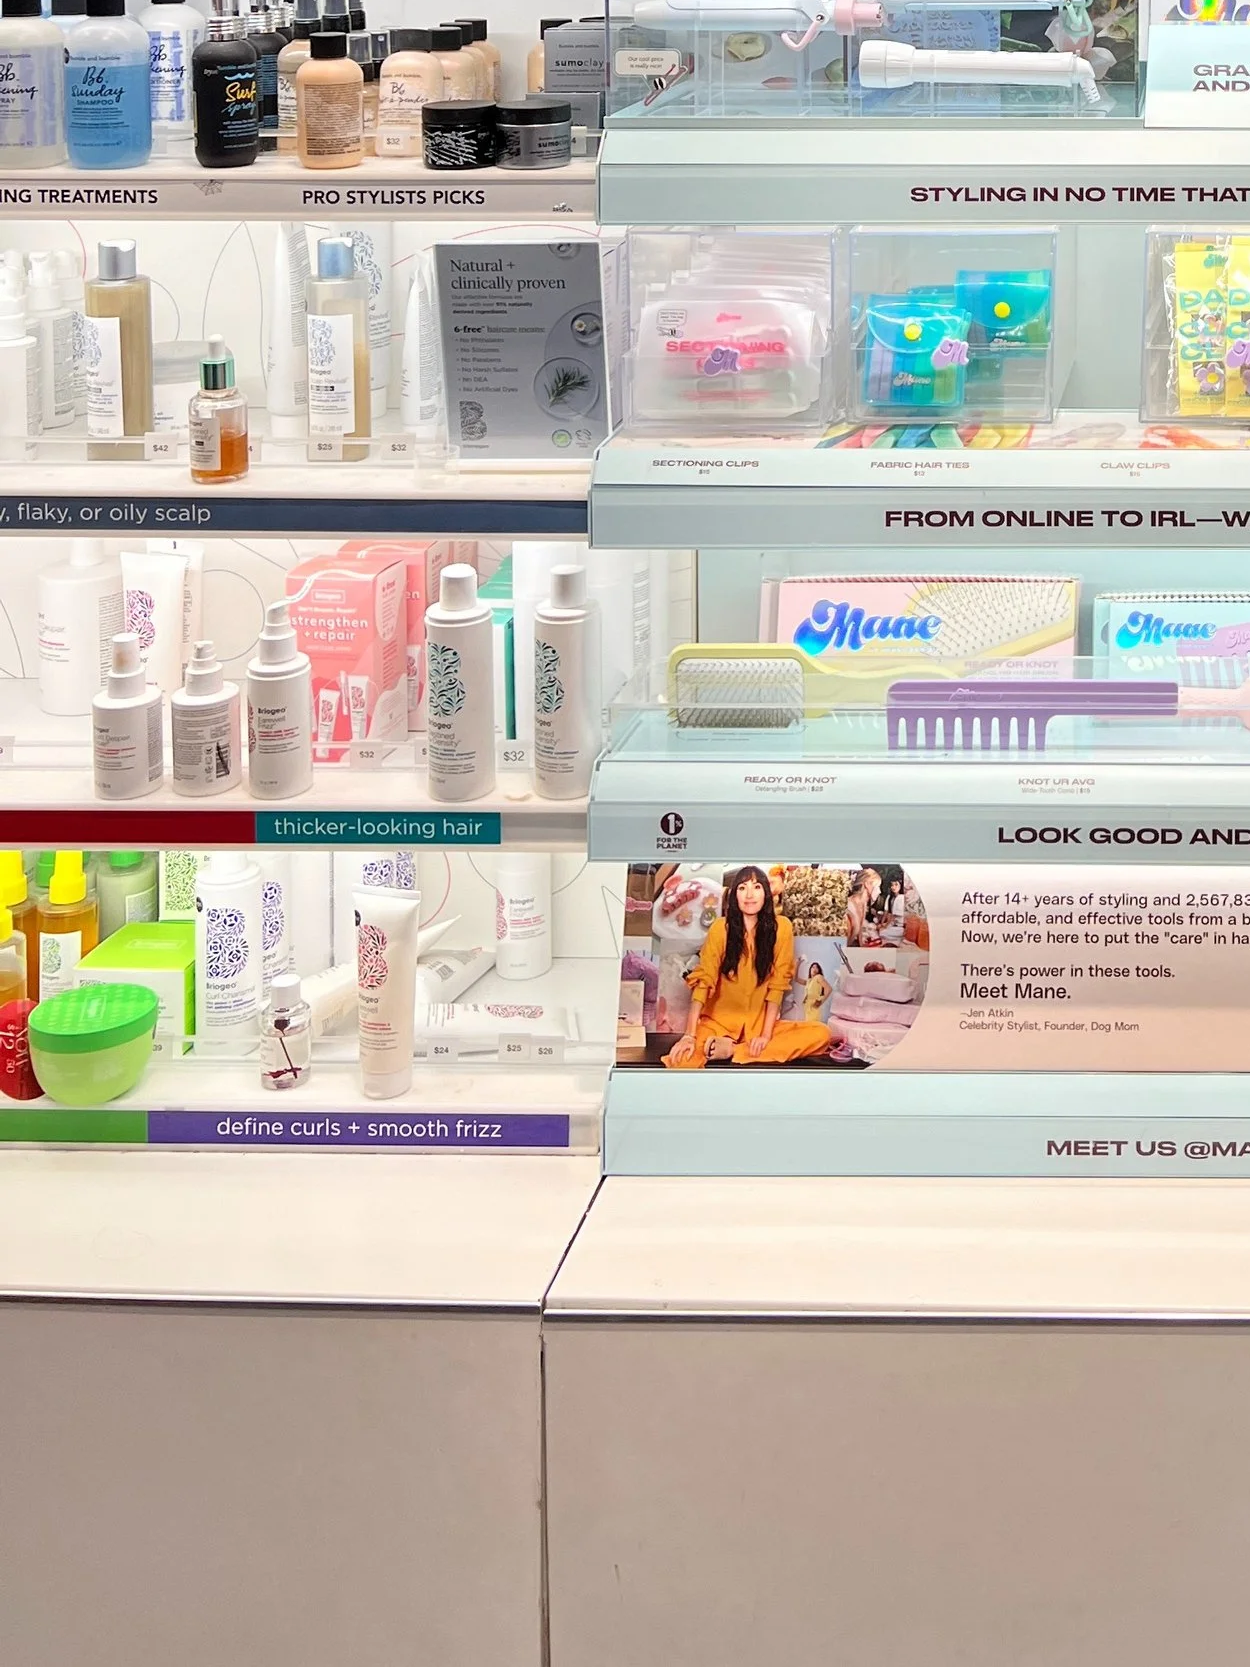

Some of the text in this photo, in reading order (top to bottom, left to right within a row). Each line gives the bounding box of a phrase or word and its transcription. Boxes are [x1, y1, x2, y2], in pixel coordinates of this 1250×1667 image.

[554, 58, 605, 68] sumoclay
[71, 84, 126, 102] Sunday
[1192, 79, 1250, 93] AND
[76, 99, 114, 107] SHAMPOO
[37, 189, 159, 204] TREATMENTS
[302, 189, 485, 205] PRO STYLISTS PICKS
[910, 186, 1027, 203] STYLING
[1032, 186, 1059, 202] IN
[1065, 186, 1106, 203] NO
[1111, 186, 1176, 202] TIME
[450, 258, 517, 273] Natural +
[450, 275, 566, 293] clinically proven
[152, 444, 169, 453] $42
[652, 459, 760, 468] SECTIONING CLIPS
[17, 502, 72, 524] flaky,
[79, 507, 103, 521] or
[109, 503, 148, 525] oily
[154, 503, 211, 525] scalp
[885, 510, 975, 528] FROM
[981, 510, 1094, 528] ONLINE
[1100, 510, 1144, 528] TO
[290, 615, 369, 630] strengthen
[313, 628, 357, 643] repair
[503, 750, 525, 762] $32
[743, 776, 838, 784] READY OR KNOT
[274, 817, 483, 839] thicker-looking hair
[998, 826, 1083, 844] LOOK
[1088, 827, 1183, 845] GOOD
[656, 837, 688, 845] FOR THE
[656, 842, 688, 850] PLANET
[961, 892, 1000, 905] After
[1003, 893, 1029, 904] 14+
[1033, 894, 1075, 909] years
[1078, 891, 1096, 906] of
[1098, 892, 1148, 910] styling
[1152, 892, 1181, 907] and
[961, 910, 1041, 927] affordable,
[1045, 911, 1073, 925] and
[1078, 911, 1143, 925] effective
[1147, 912, 1184, 926] tools
[1188, 912, 1223, 926] from
[1227, 915, 1237, 926] a
[960, 982, 1071, 1000] Meet Mane.
[506, 1043, 522, 1053] $25
[216, 1116, 502, 1138] define curls + smooth frizz
[1046, 1140, 1129, 1157] MEET
[1135, 1140, 1177, 1157] US
